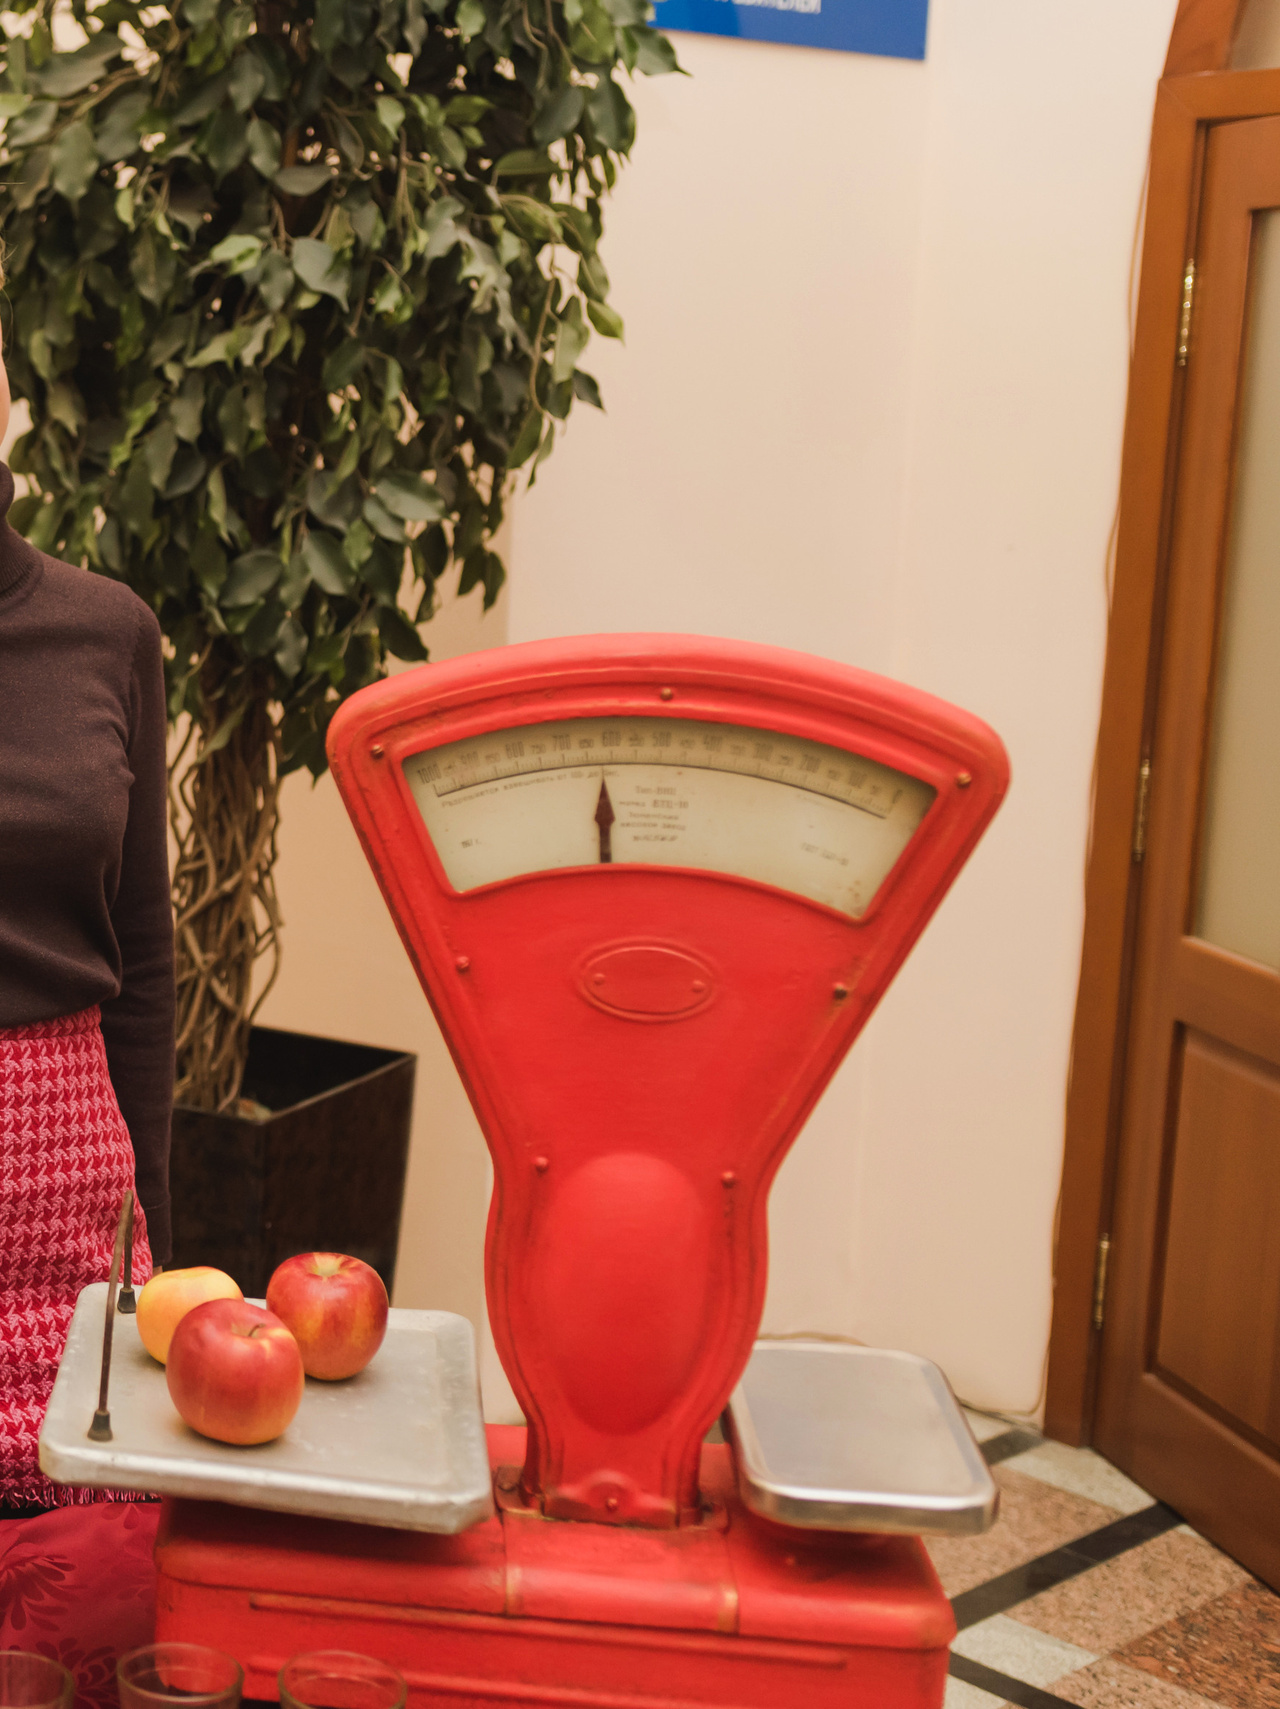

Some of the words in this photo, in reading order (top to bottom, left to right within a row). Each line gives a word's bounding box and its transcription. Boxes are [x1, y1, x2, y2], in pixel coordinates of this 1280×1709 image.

[505, 741, 525, 759] 800
[552, 734, 571, 750] 700
[602, 731, 621, 747] 600
